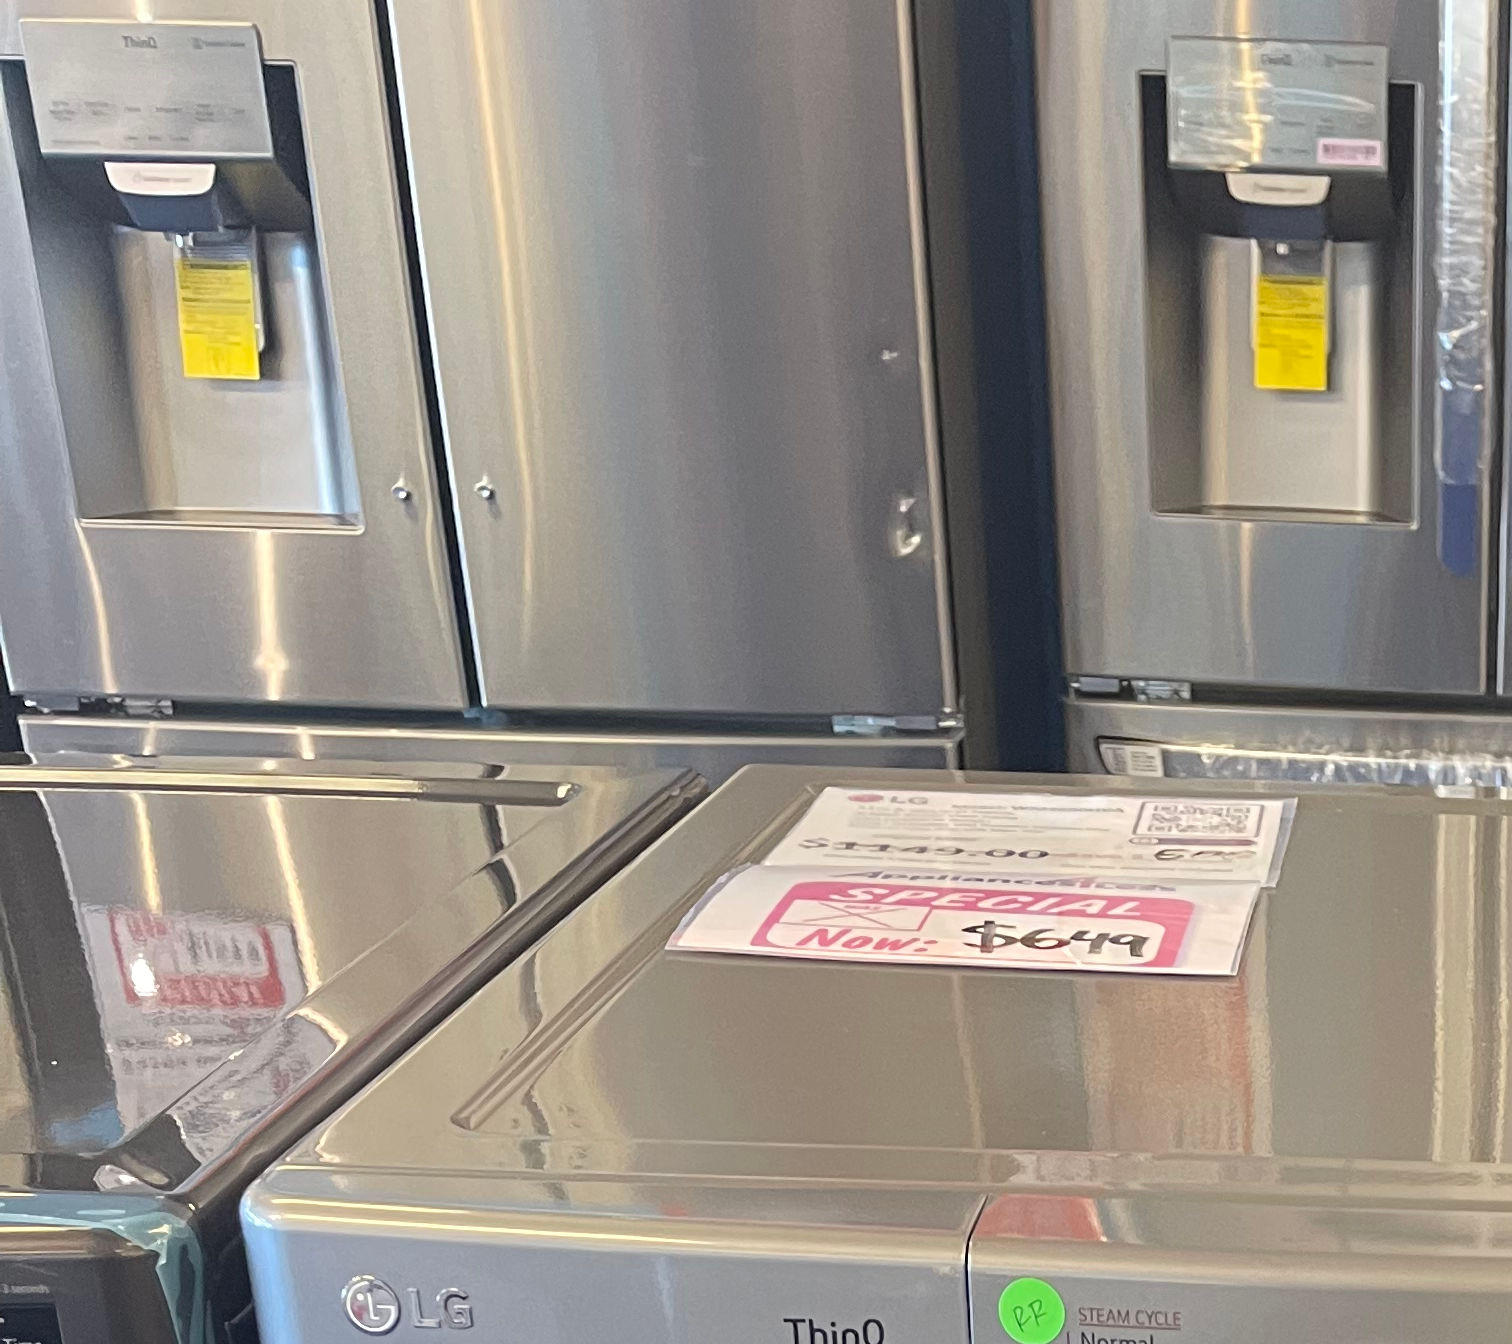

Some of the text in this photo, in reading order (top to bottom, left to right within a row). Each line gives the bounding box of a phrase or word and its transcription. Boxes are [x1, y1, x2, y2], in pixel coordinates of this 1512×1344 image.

[828, 886, 1145, 917] SPECIAL
[799, 919, 1150, 958] Now: $649
[406, 1287, 475, 1330] LG
[1078, 1306, 1182, 1327] STEAM CYCLE
